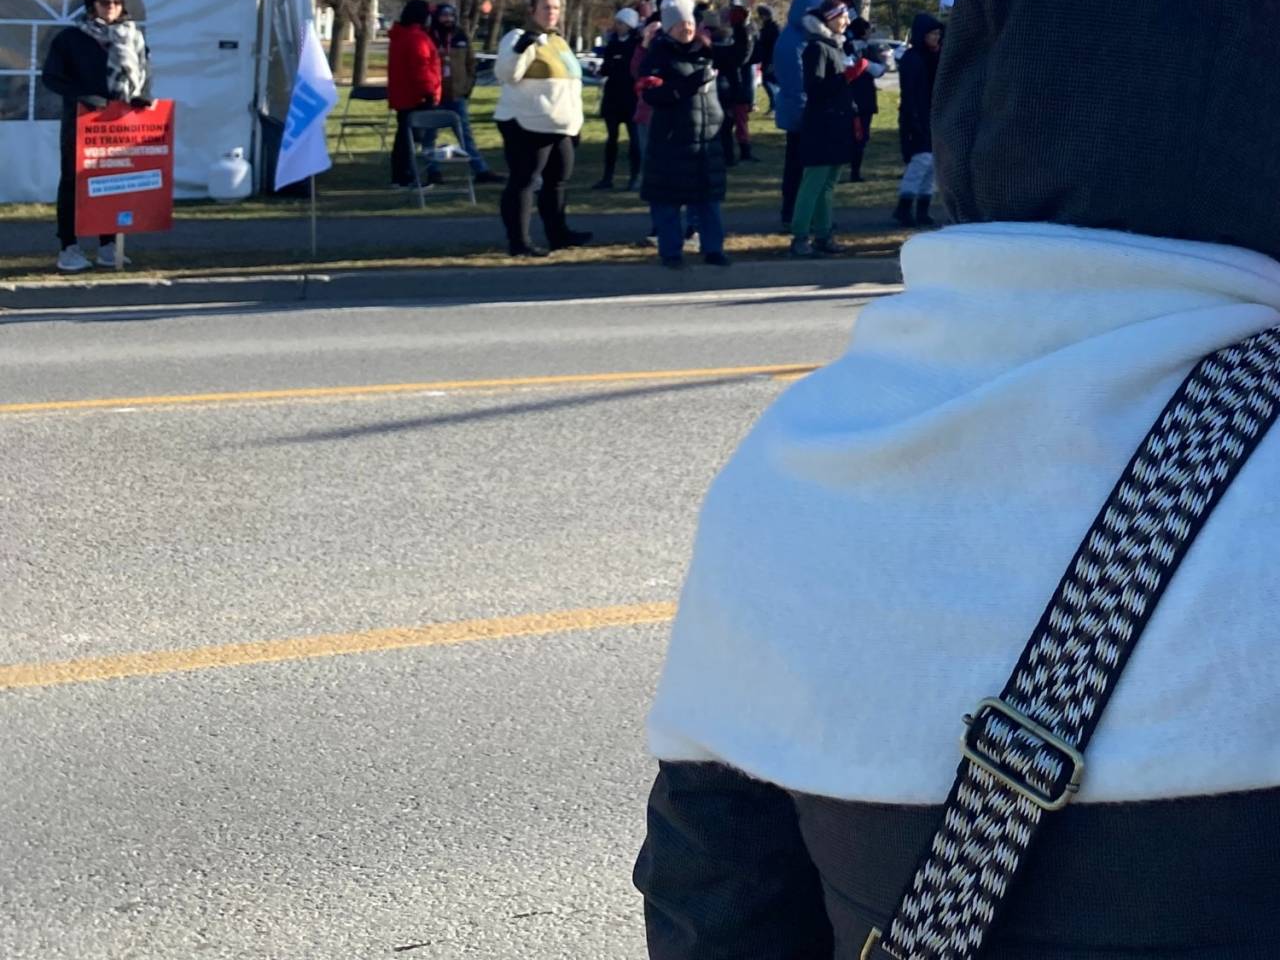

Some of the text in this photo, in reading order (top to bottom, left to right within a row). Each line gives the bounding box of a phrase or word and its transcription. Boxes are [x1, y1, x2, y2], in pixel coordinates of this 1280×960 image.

[85, 125, 107, 134] NOS
[85, 136, 97, 145] DE
[100, 135, 139, 144] TRAVAIL
